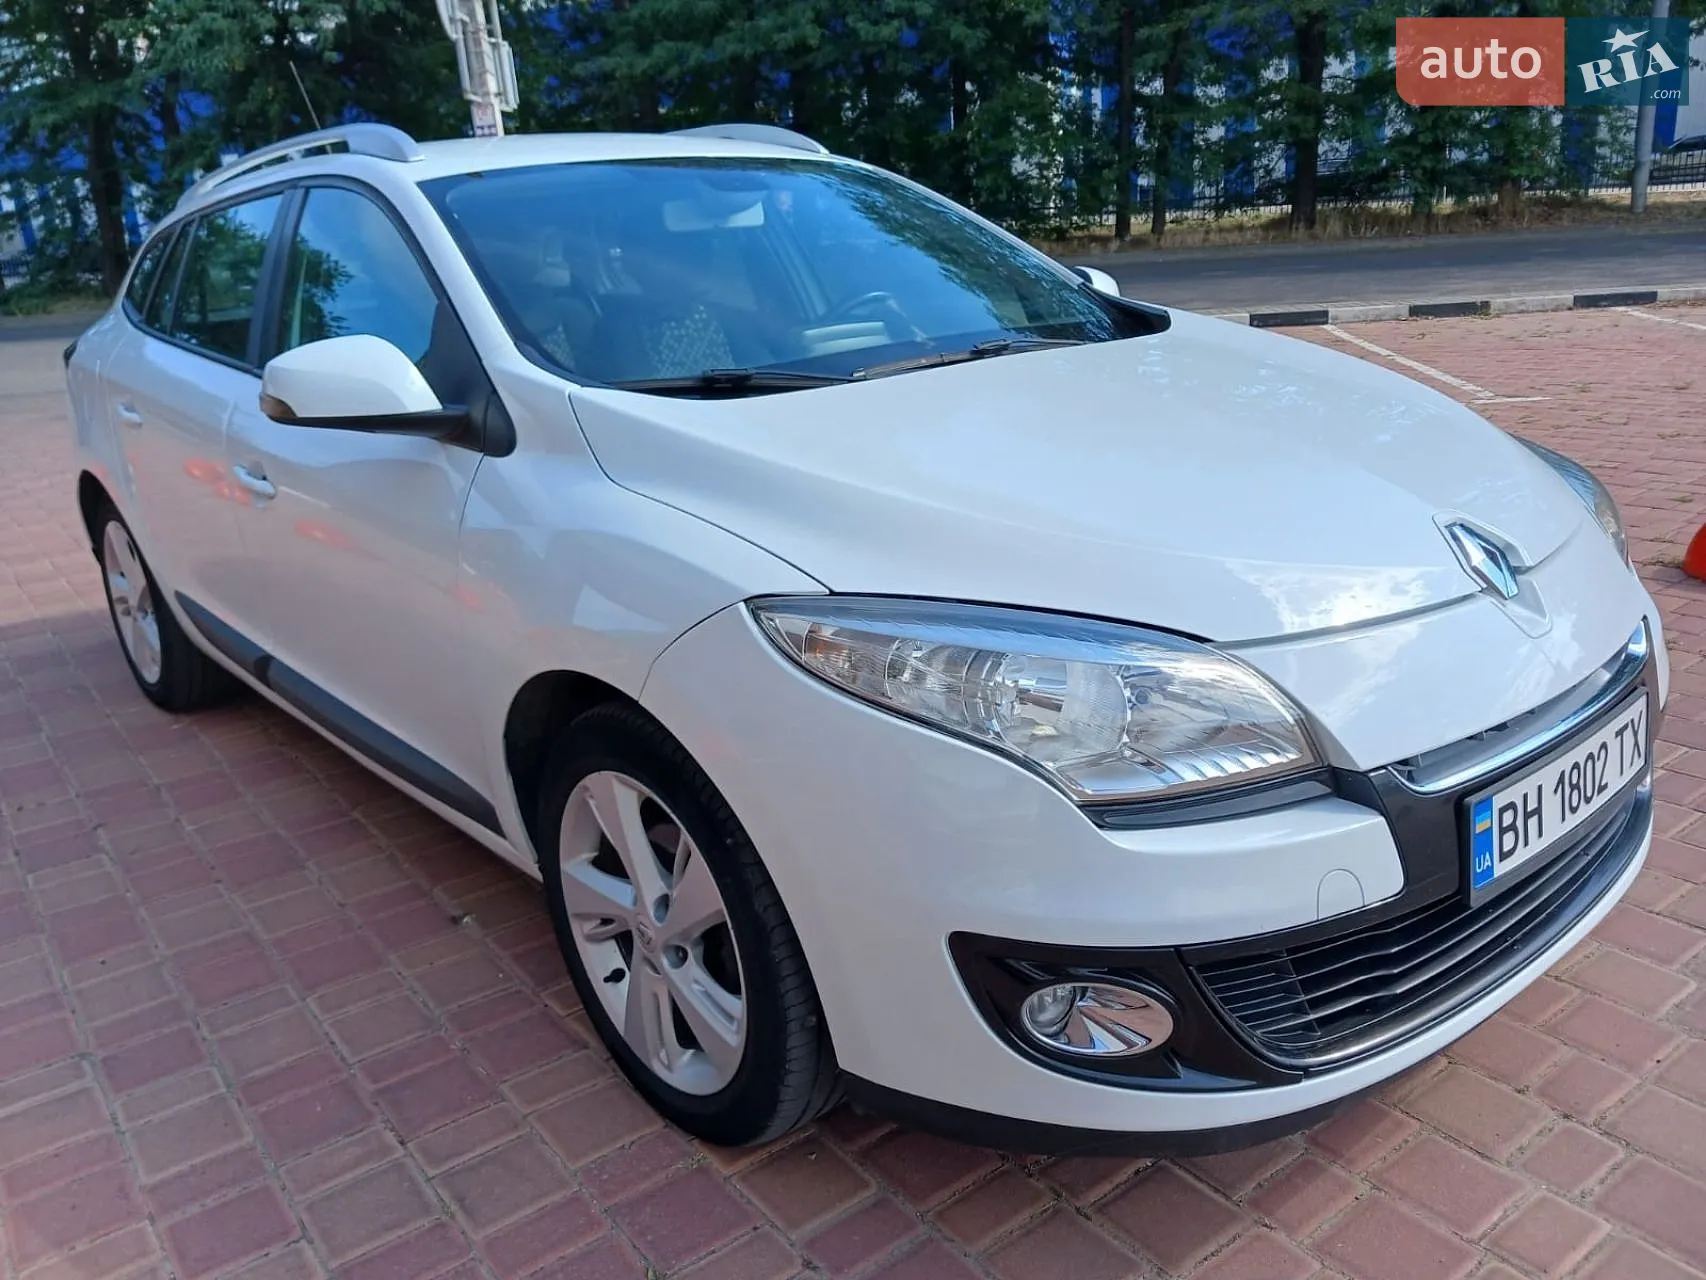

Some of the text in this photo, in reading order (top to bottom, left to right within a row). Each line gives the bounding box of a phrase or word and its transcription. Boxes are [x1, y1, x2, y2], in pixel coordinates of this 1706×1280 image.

[1498, 710, 1644, 863] BH 1802 TX
[1475, 851, 1492, 873] UA
